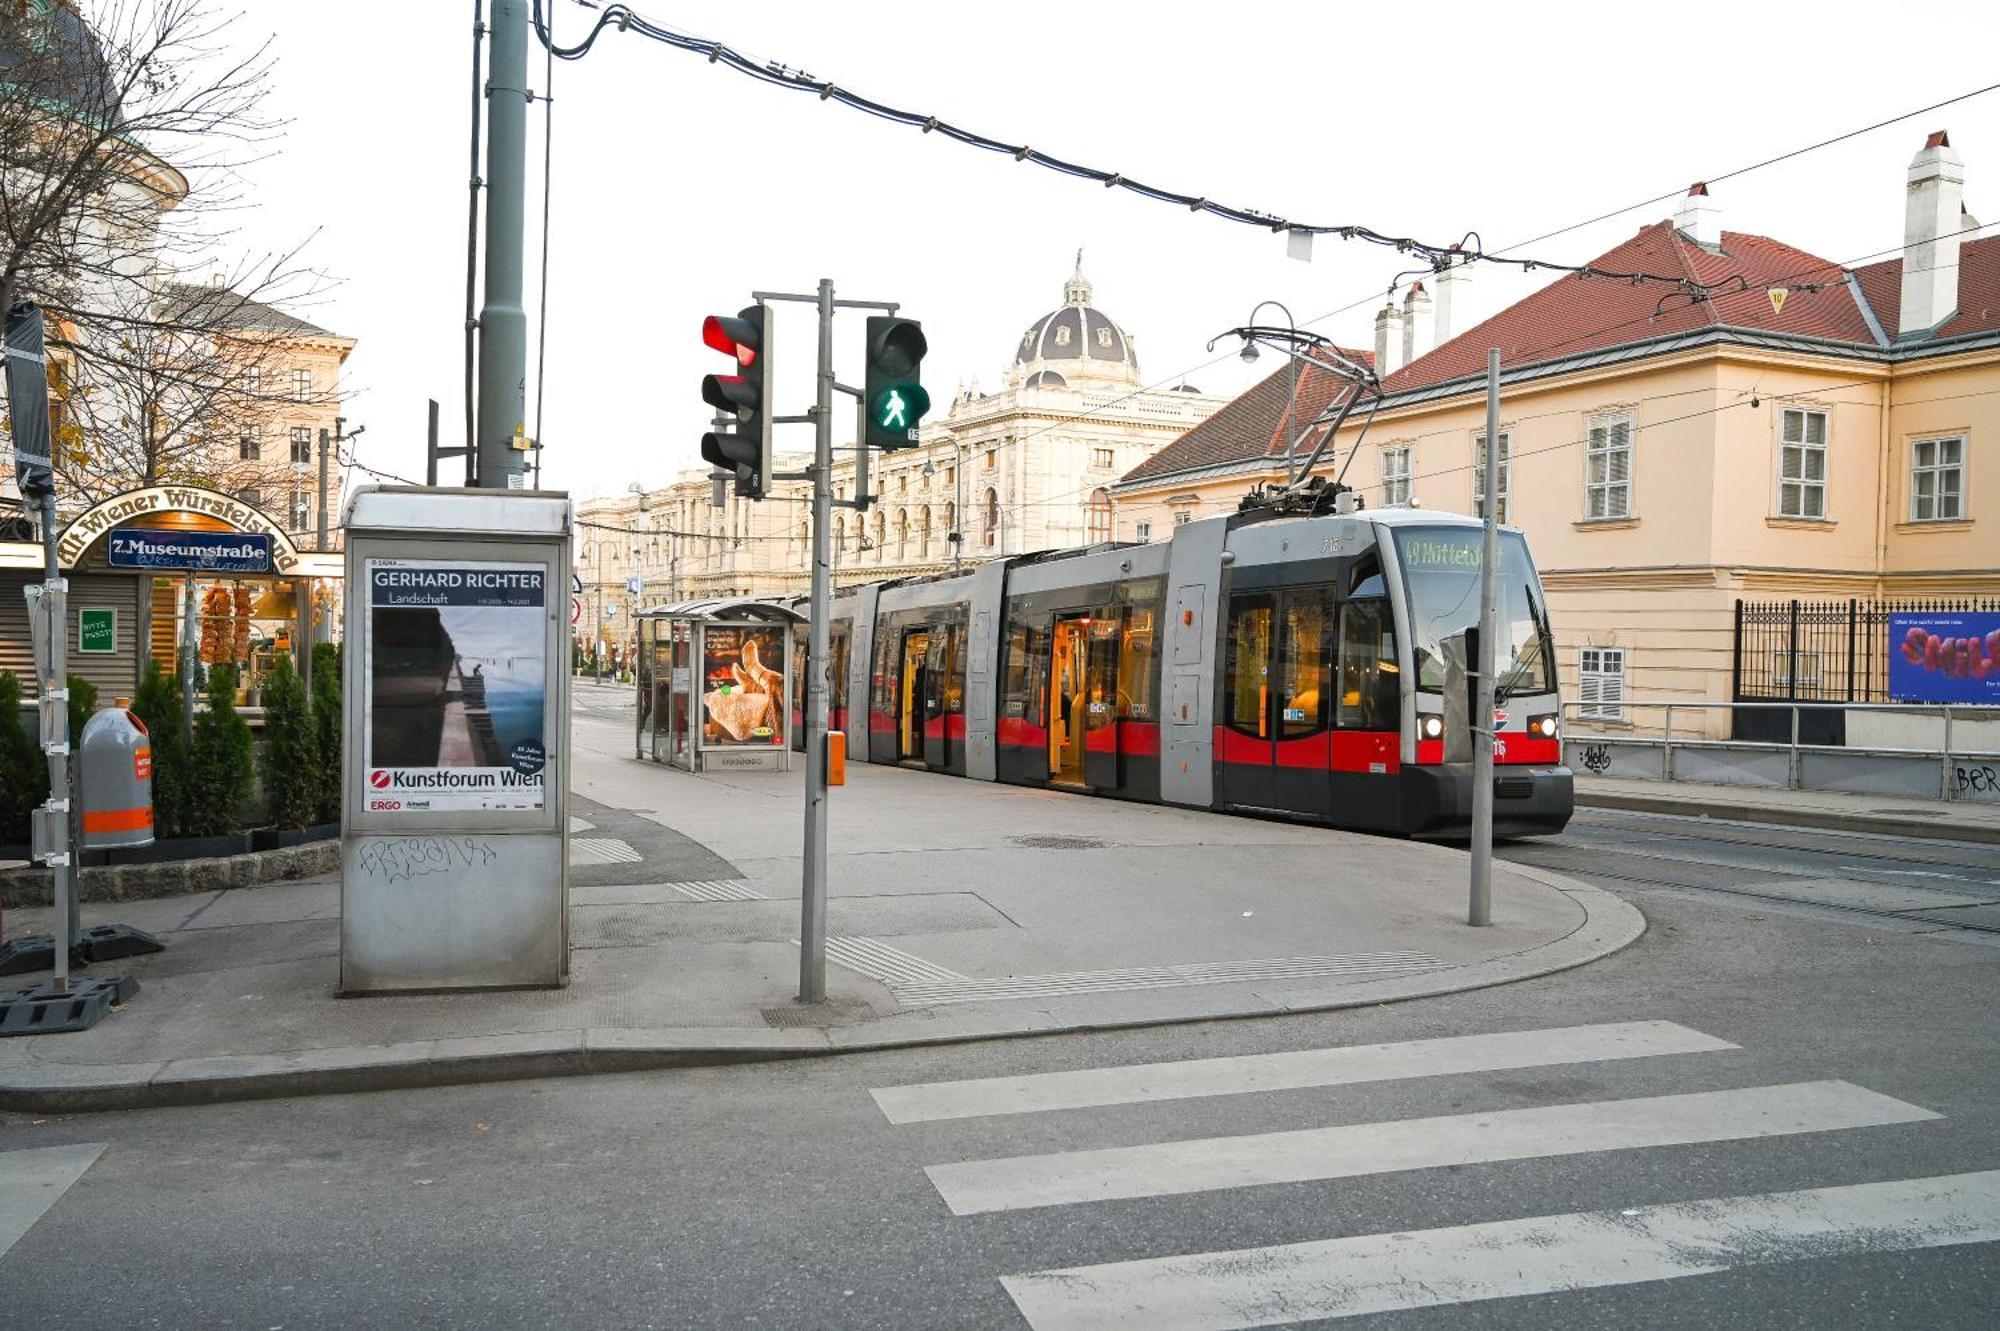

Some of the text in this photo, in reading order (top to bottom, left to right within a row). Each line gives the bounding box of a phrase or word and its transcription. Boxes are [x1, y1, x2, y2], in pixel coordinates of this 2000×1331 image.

[128, 540, 266, 559] Museumstraße
[375, 572, 541, 589] GERHARD RICHTER
[389, 592, 448, 604] Landschaft
[393, 770, 544, 788] Kunstforum Wien
[371, 801, 401, 810] ERGO
